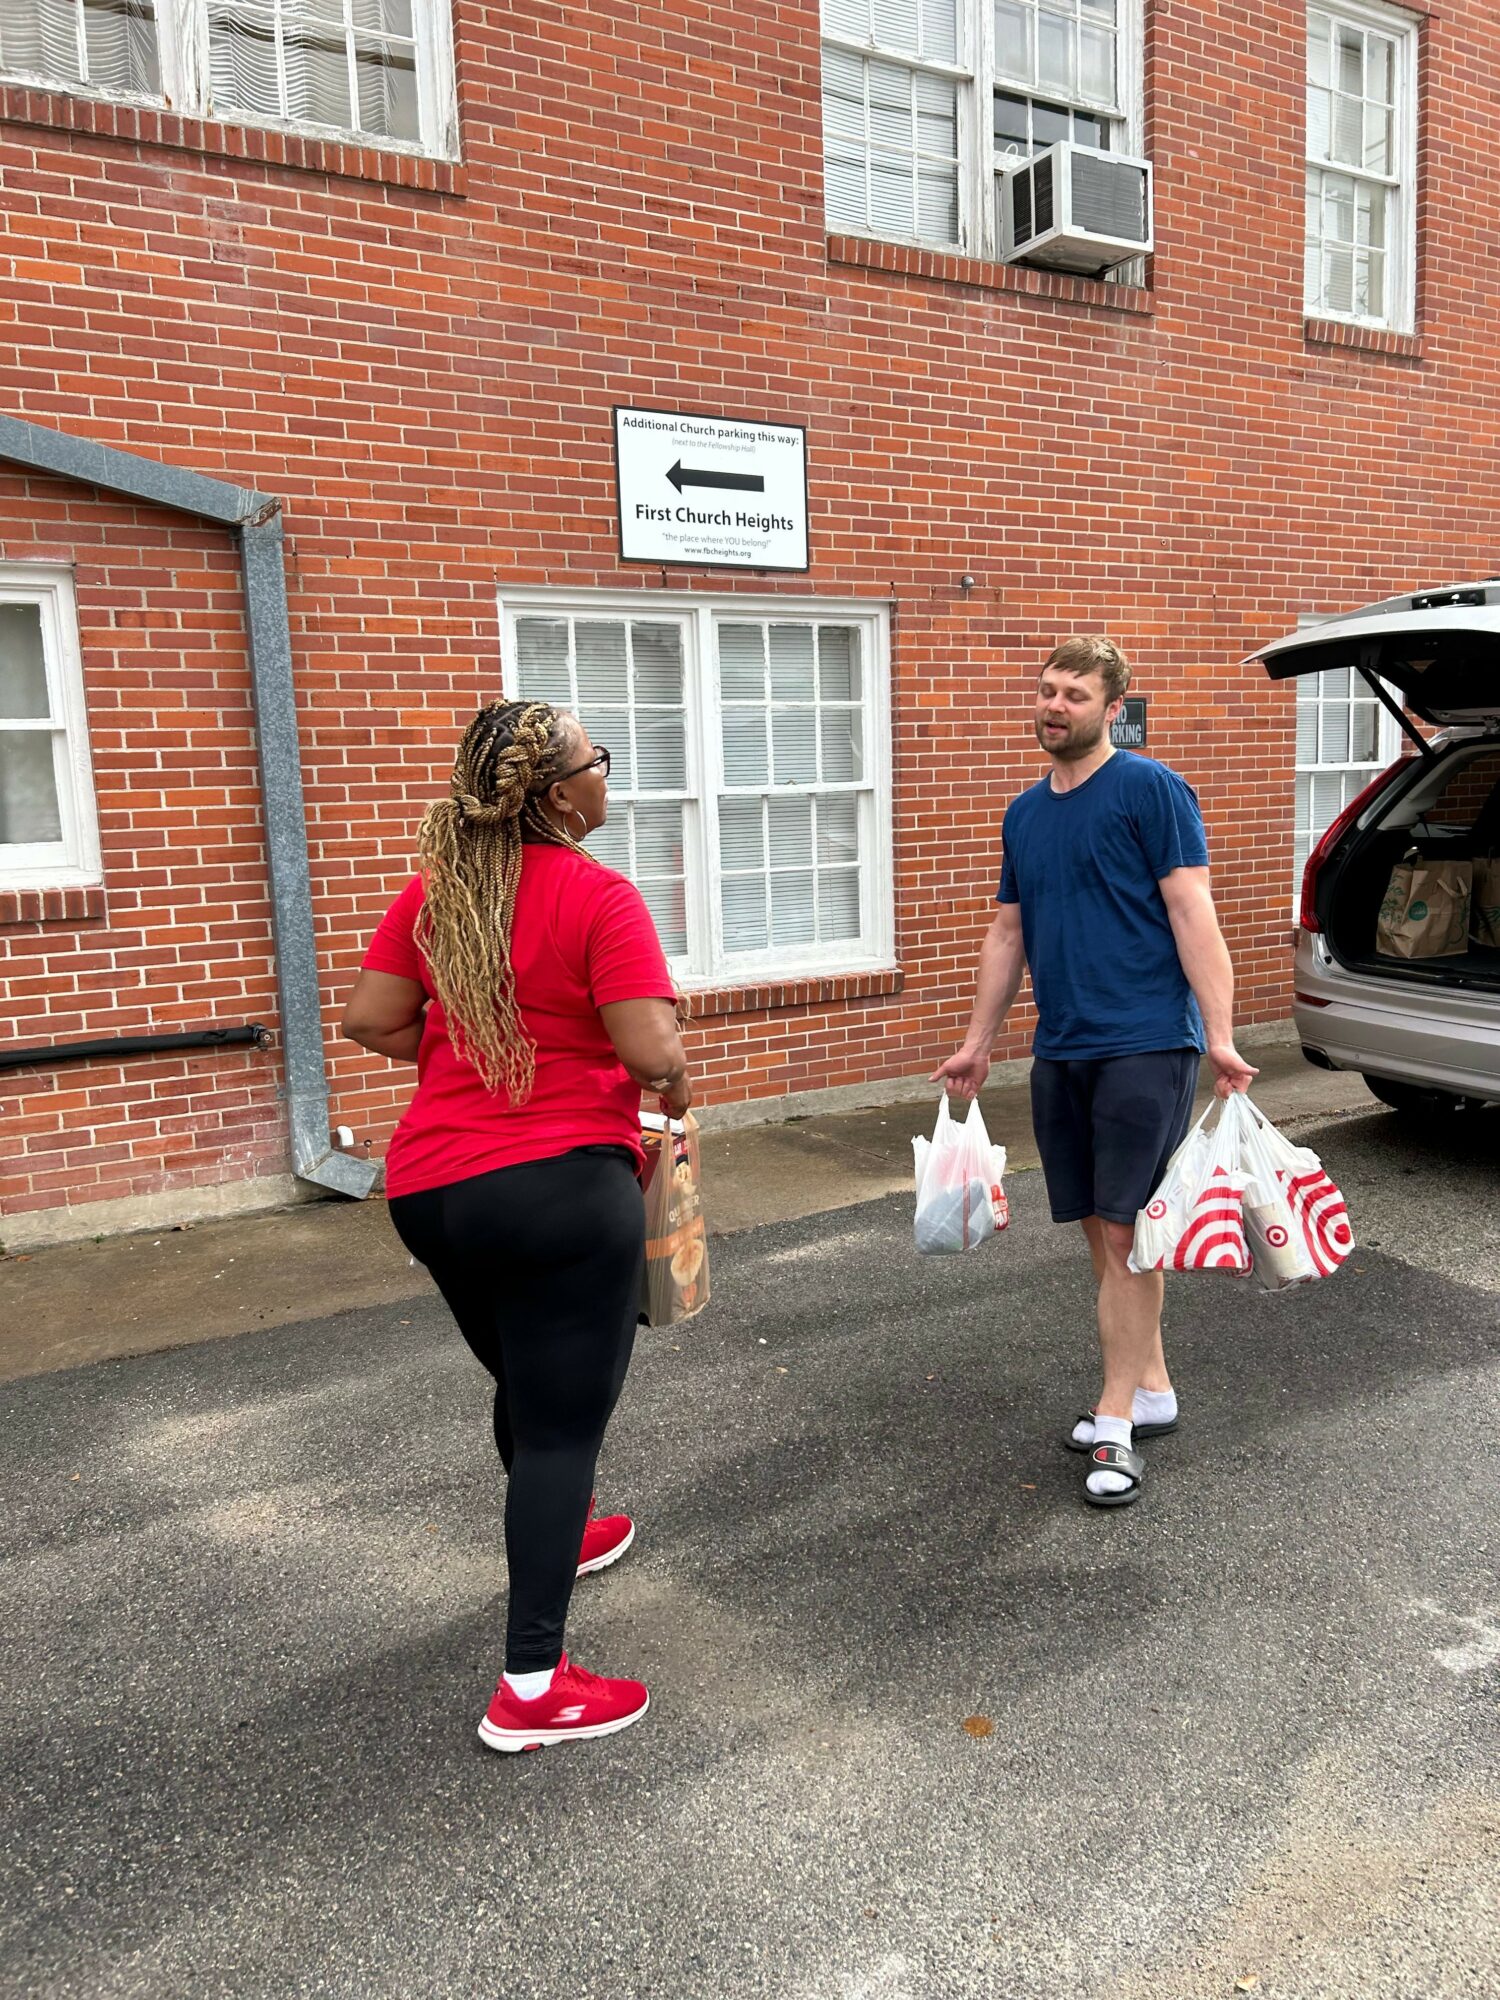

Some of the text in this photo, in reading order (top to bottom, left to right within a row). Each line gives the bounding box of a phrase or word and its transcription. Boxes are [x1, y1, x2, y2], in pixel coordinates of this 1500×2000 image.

[623, 416, 799, 447] Additional Church parking this way:
[671, 437, 689, 447] (next
[689, 439, 696, 447] to
[696, 440, 707, 449] the
[708, 441, 740, 452] Fellowship
[635, 503, 794, 533] First Church Heights
[679, 533, 700, 543] place
[700, 535, 724, 545] where
[724, 536, 741, 546] YOU
[684, 547, 752, 558] www.fbcheights.org
[1111, 724, 1142, 743] RKING
